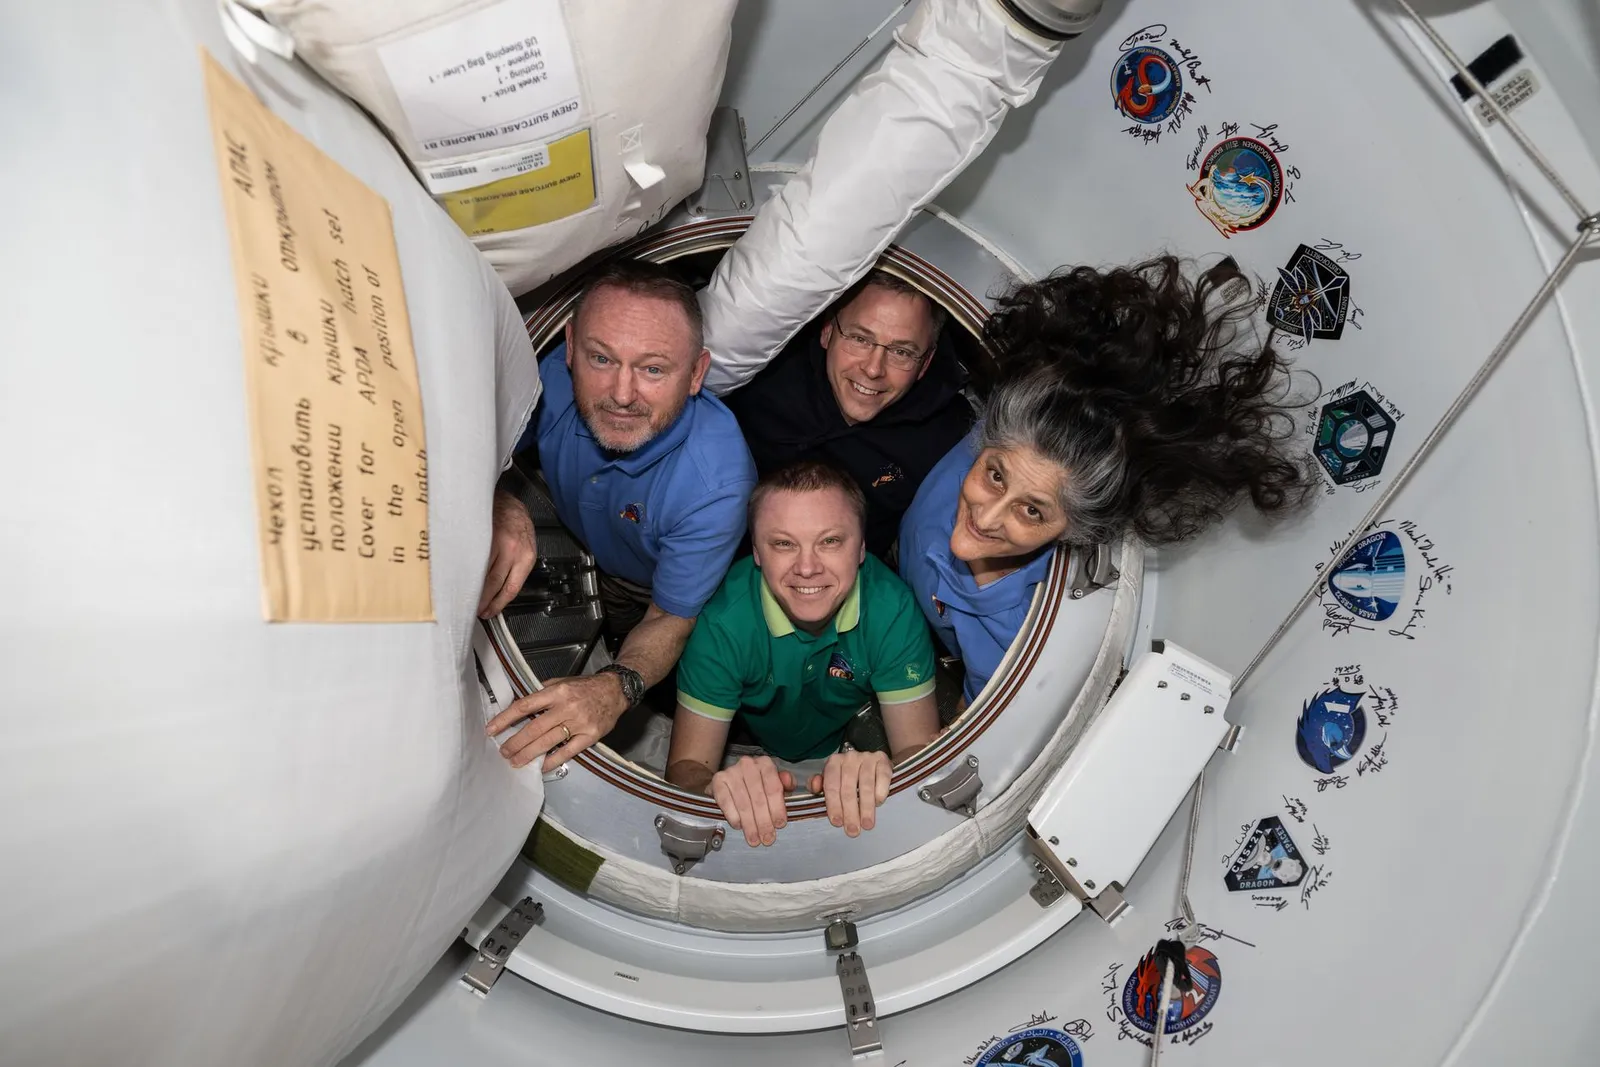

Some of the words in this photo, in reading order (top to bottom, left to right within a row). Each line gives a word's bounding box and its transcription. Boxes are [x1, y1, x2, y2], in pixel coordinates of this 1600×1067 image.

[486, 41, 524, 61] Sleeping
[524, 36, 538, 46] US
[466, 52, 486, 68] Bag
[507, 48, 541, 68] Hygiene
[443, 64, 467, 78] Liner
[496, 65, 501, 74] 4
[509, 60, 545, 80] Clothing
[494, 84, 516, 98] Brick
[519, 71, 548, 91] 2-Week
[1502, 76, 1525, 93] CELL
[1508, 80, 1531, 97] LINE
[481, 94, 487, 103] 4
[1487, 86, 1533, 123] RETRAINT
[551, 101, 579, 119] CREW
[502, 112, 550, 135] SUITCASE
[424, 142, 438, 150] B1
[440, 128, 500, 147] (WILMORE)
[1242, 140, 1274, 162] MOGENSEN
[224, 129, 255, 199] АПАС
[518, 180, 558, 196] SUITCASE
[559, 172, 581, 186] CREW
[1270, 164, 1281, 198] MOGHBELI
[474, 190, 518, 204] (WILMORE)
[322, 207, 344, 245] set
[1304, 248, 1342, 275] CRISTOFORETTI
[332, 258, 358, 315] hatch
[361, 264, 381, 288] of
[252, 272, 286, 368] крышки
[1338, 296, 1348, 324] WATKINS
[320, 299, 348, 386] крышки
[369, 295, 398, 370] position
[352, 346, 376, 406] APDA
[392, 400, 410, 448] open
[356, 442, 375, 476] for
[290, 397, 323, 552] установить
[327, 423, 348, 552] положении
[388, 484, 404, 518] the
[358, 496, 376, 559] Cover
[416, 529, 430, 562] the
[1357, 532, 1388, 550] DRAGON
[388, 545, 405, 564] in
[1358, 608, 1378, 620] NASA
[1275, 824, 1295, 854] SPACEX
[1240, 880, 1275, 889] DRAGON
[1124, 976, 1138, 1016] KIMBROUGH
[1168, 1012, 1200, 1032] HOSHIDE
[980, 1041, 1008, 1065] HOBURG
[1055, 1033, 1080, 1057] ФЕДЯЕВ
